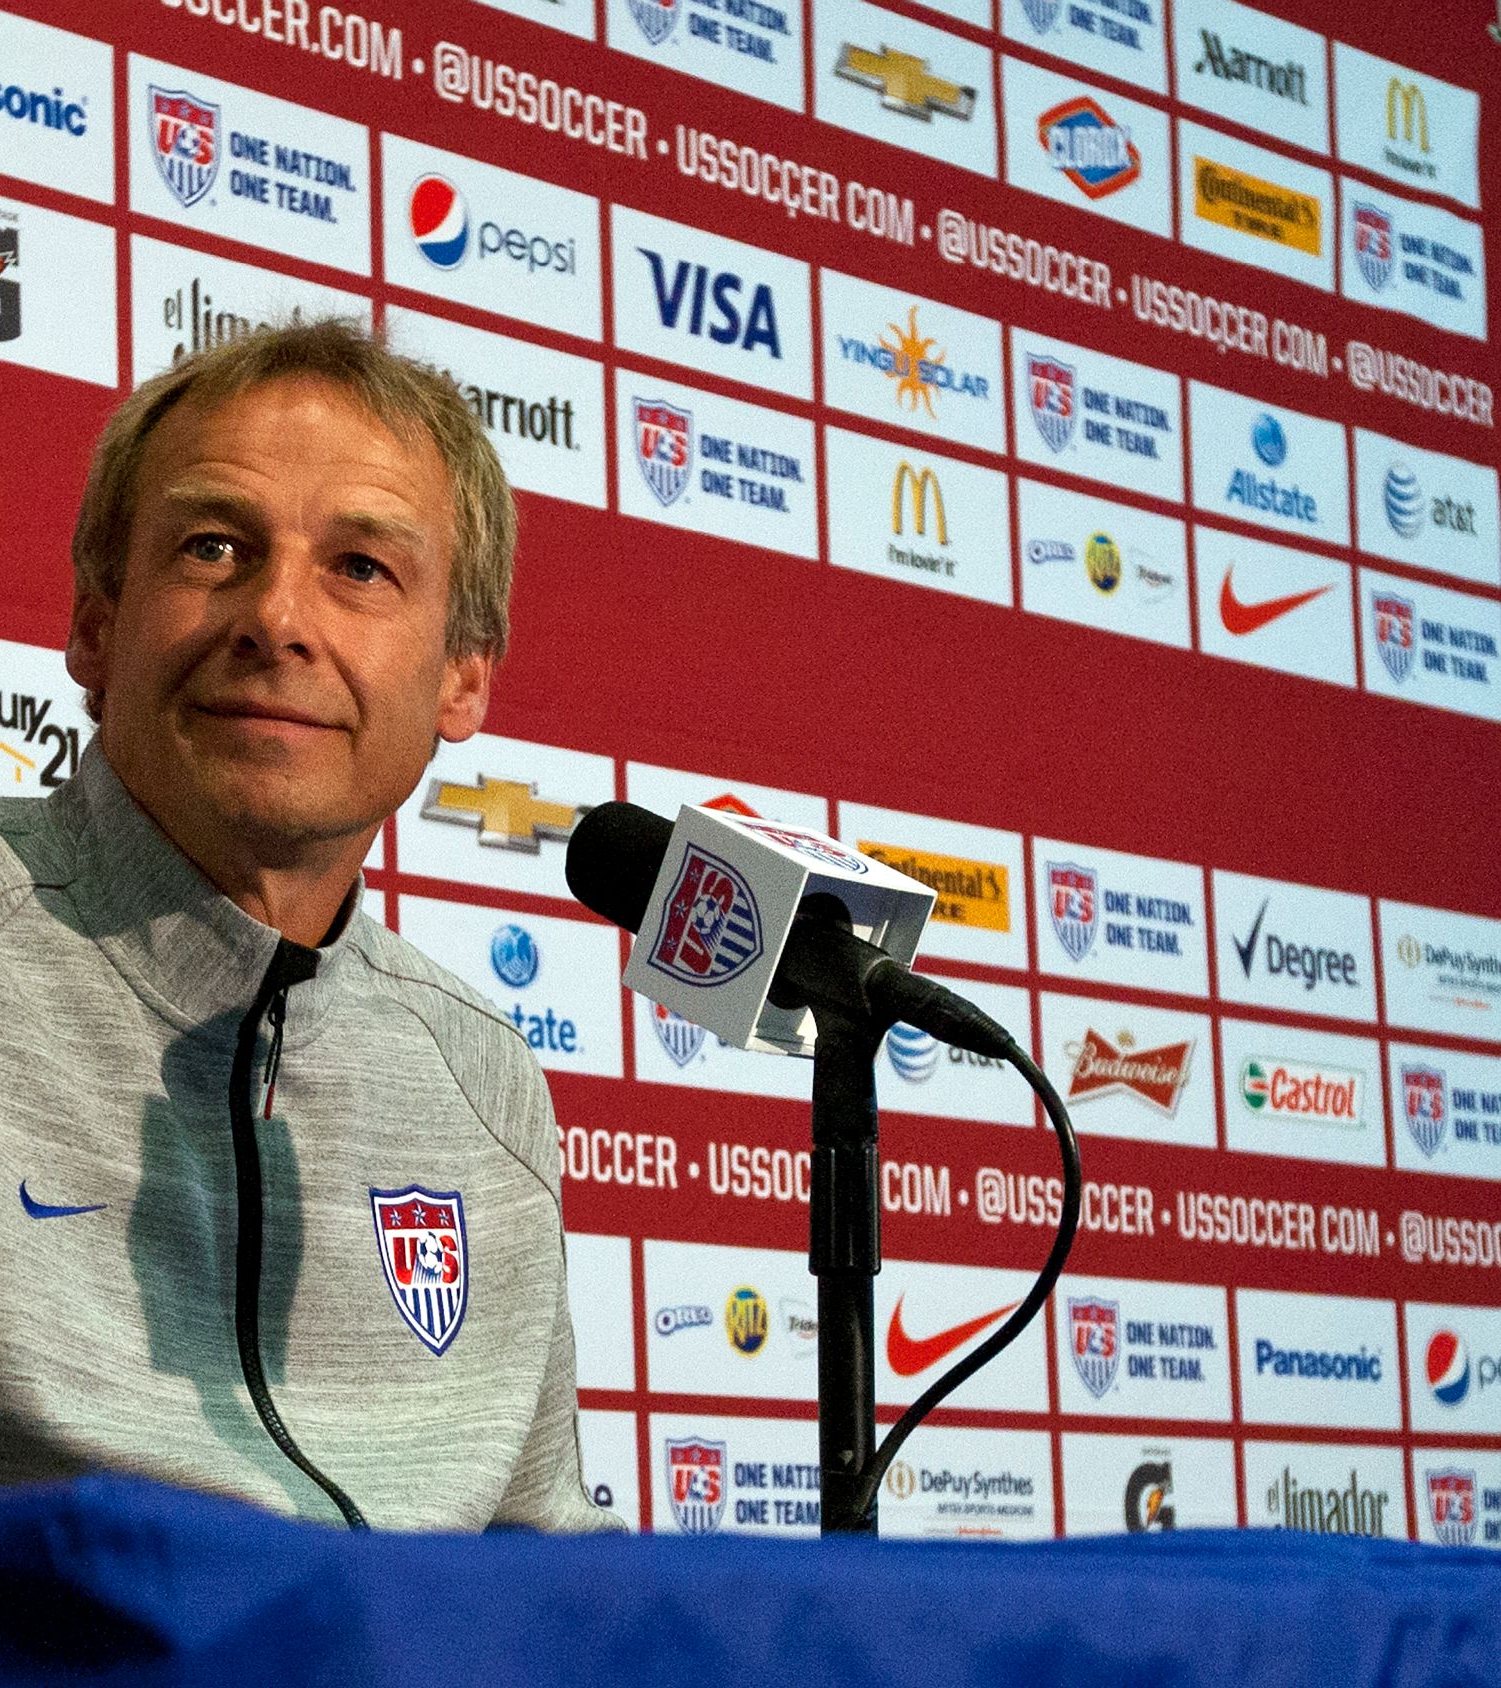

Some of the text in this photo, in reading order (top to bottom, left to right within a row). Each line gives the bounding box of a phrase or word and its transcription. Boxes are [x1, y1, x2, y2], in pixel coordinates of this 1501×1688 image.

[229, 131, 357, 192] ONE NATION.
[161, 0, 402, 80] CER.COM
[434, 41, 647, 159] @USSOCCER
[938, 209, 1110, 308] @USSOCCER
[1346, 341, 1493, 427] @USSOCCER
[229, 169, 338, 224] ONE TEAM.
[478, 221, 577, 276] pepsi
[636, 247, 783, 360] VISA
[918, 359, 990, 399] SOLAR
[1082, 387, 1111, 415] ONE
[1084, 418, 1112, 447] ONE
[700, 432, 805, 484] ONE NATION.
[700, 472, 791, 514] ONE TEAM.
[1226, 467, 1318, 524] Allstate
[39, 723, 79, 788] 21
[1104, 888, 1135, 917] ONE
[1106, 922, 1136, 950] ONE
[1270, 1066, 1357, 1119] Castrol
[975, 1166, 1154, 1236] @USSCCER
[1127, 1321, 1156, 1345] ONE
[1128, 1354, 1156, 1378] ONE
[1256, 1338, 1381, 1384] Panasonic
[734, 1463, 767, 1488] ONE
[921, 1469, 1034, 1500] DePuy Synthes
[736, 1499, 768, 1524] ONE
[1284, 1465, 1389, 1537] limador
